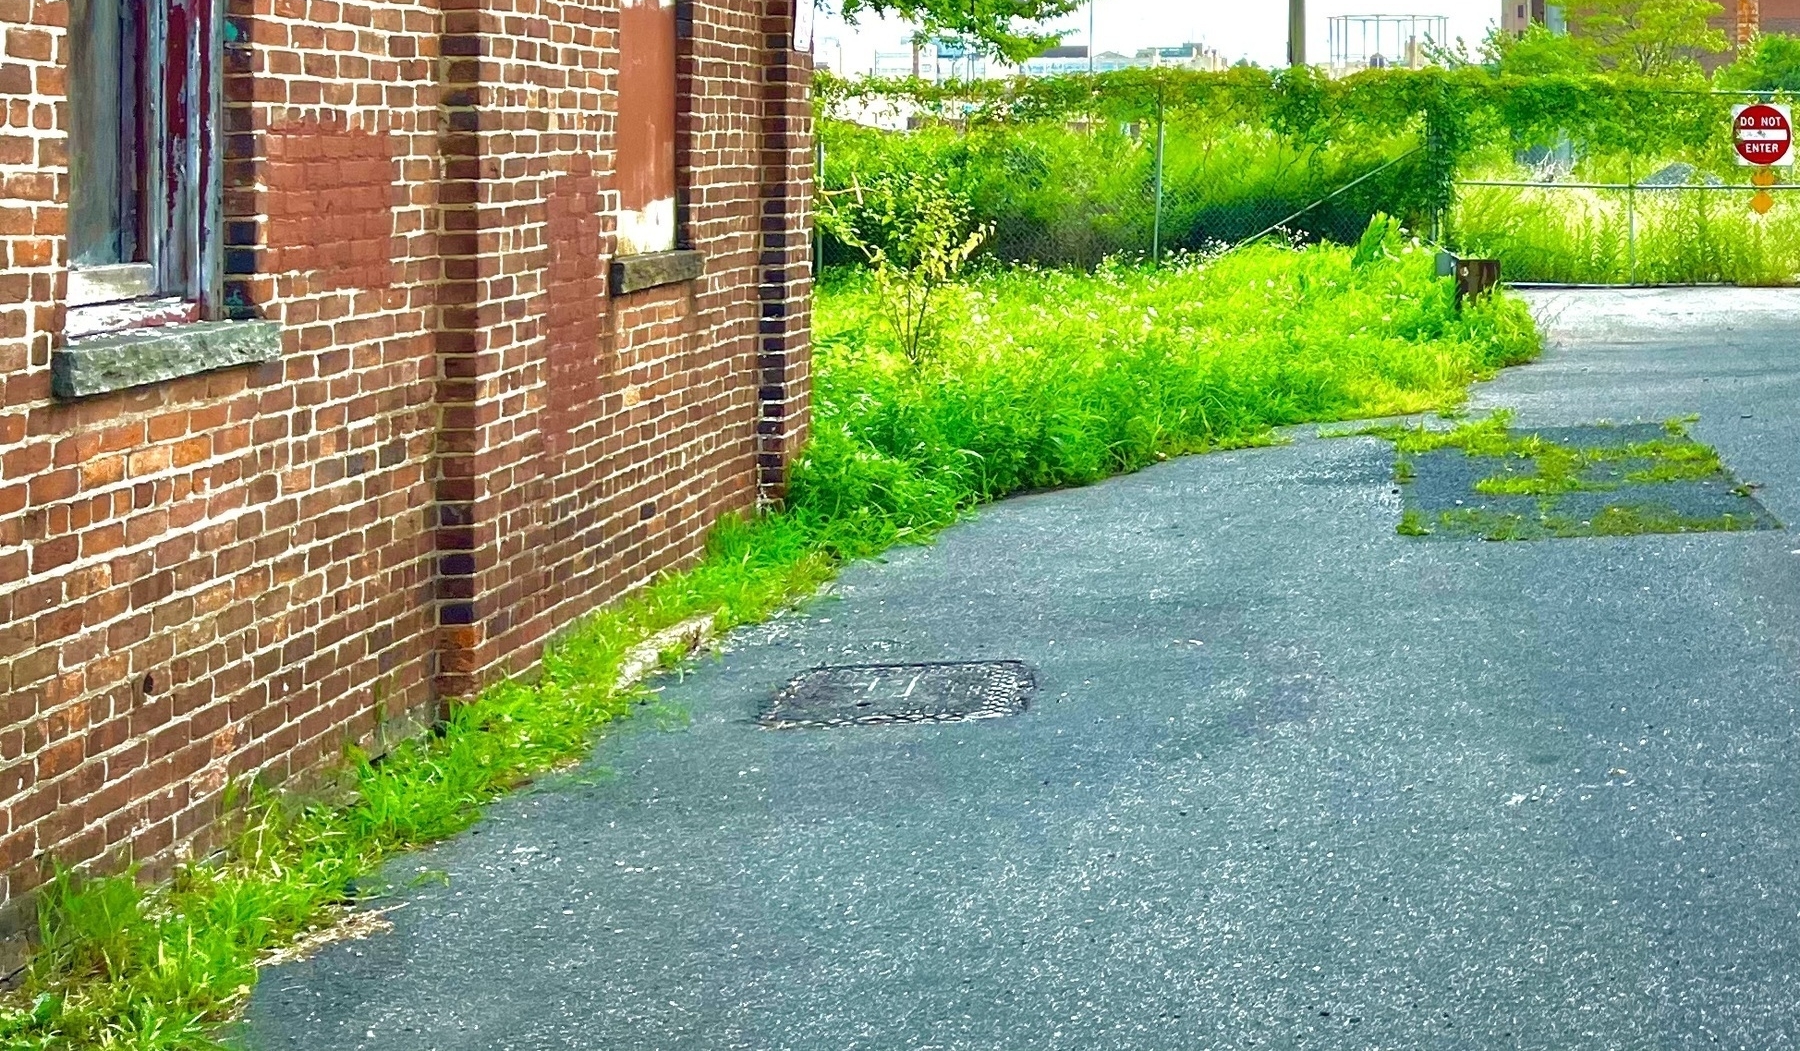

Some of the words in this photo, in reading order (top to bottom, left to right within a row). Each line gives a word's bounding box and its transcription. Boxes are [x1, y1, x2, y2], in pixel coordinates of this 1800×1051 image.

[1740, 116, 1755, 127] DO
[1760, 116, 1781, 127] NOT
[1745, 143, 1779, 153] ENTER
